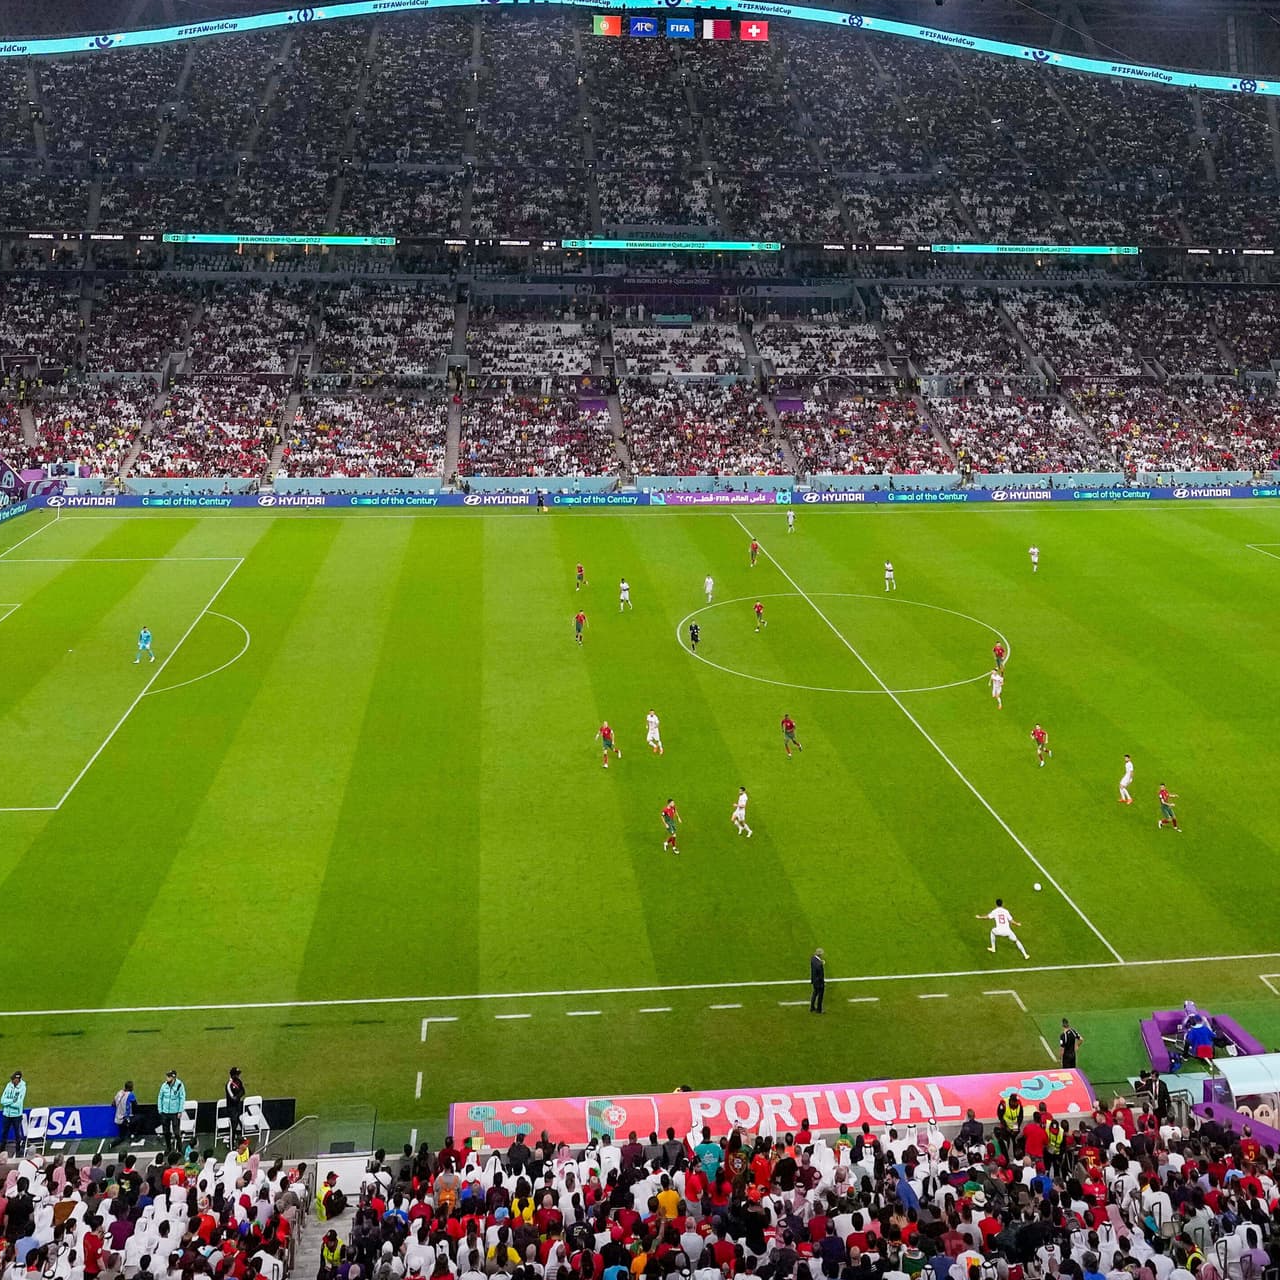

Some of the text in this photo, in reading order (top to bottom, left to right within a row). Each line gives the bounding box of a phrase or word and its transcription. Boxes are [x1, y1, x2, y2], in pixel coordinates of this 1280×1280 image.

[373, 0, 430, 10] #FIFAWorldCup
[737, 2, 792, 14] #FIFAWorldCup
[177, 23, 239, 36] #FIFAWorldCup
[670, 24, 690, 32] FIFA
[920, 30, 976, 46] #FIFAWorldCup
[1111, 66, 1174, 81] #FIFAWorldCup
[822, 493, 866, 502] HYUNDAI
[916, 493, 924, 501] of
[925, 493, 937, 501] the
[939, 493, 968, 502] Century
[1009, 491, 1051, 499] HYUNDAI
[1191, 489, 1231, 497] HYUNDAI
[68, 497, 117, 506] HYUNDAI
[173, 497, 182, 505] of
[183, 497, 197, 505] the
[199, 497, 232, 507] Century
[279, 496, 326, 505] HYUNDAI
[381, 496, 390, 504] of
[391, 496, 405, 504] the
[406, 496, 439, 506] Century
[484, 495, 530, 505] HYUNDAI
[583, 495, 591, 504] of
[592, 495, 606, 504] the
[607, 495, 639, 505] Century
[688, 1082, 962, 1128] PORTUGAL
